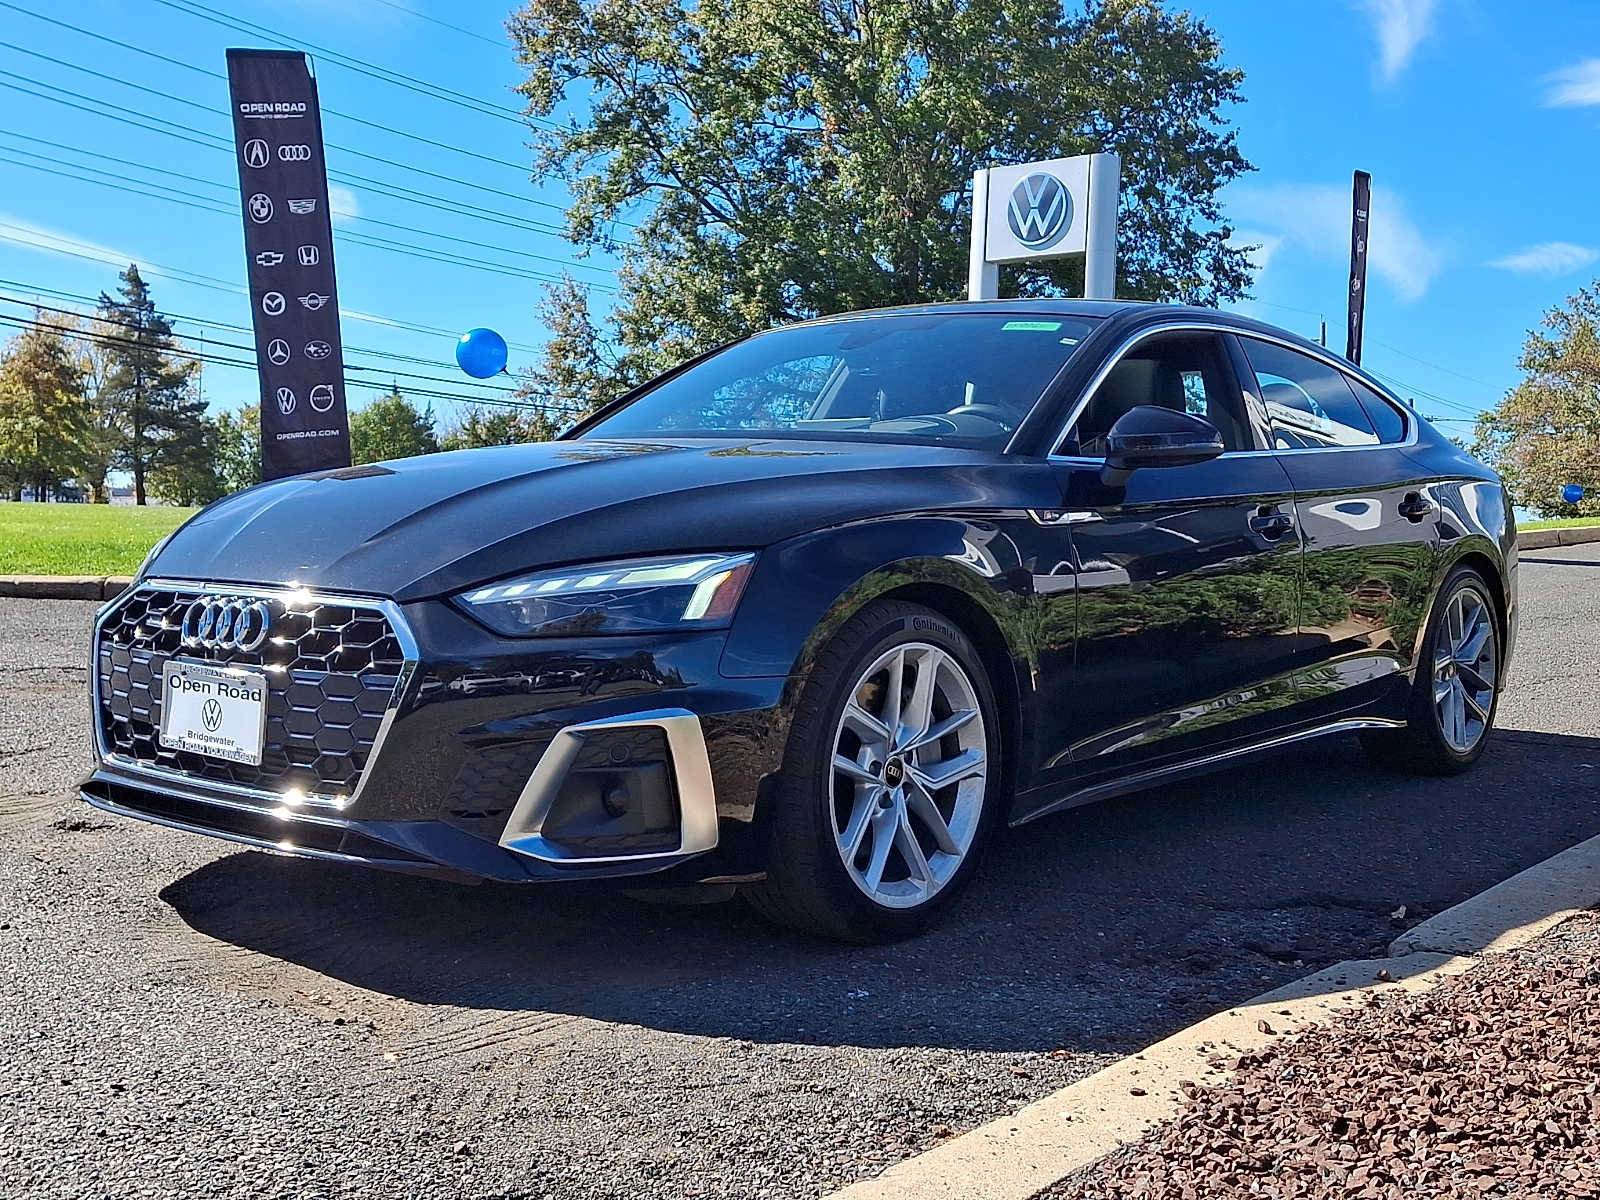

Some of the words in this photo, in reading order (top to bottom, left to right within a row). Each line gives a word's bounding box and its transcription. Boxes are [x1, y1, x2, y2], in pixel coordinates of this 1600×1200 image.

[240, 103, 273, 112] OPEN
[275, 103, 306, 112] ROAD
[169, 674, 211, 694] Open
[217, 682, 262, 702] Road
[187, 730, 235, 747] Bridgewater
